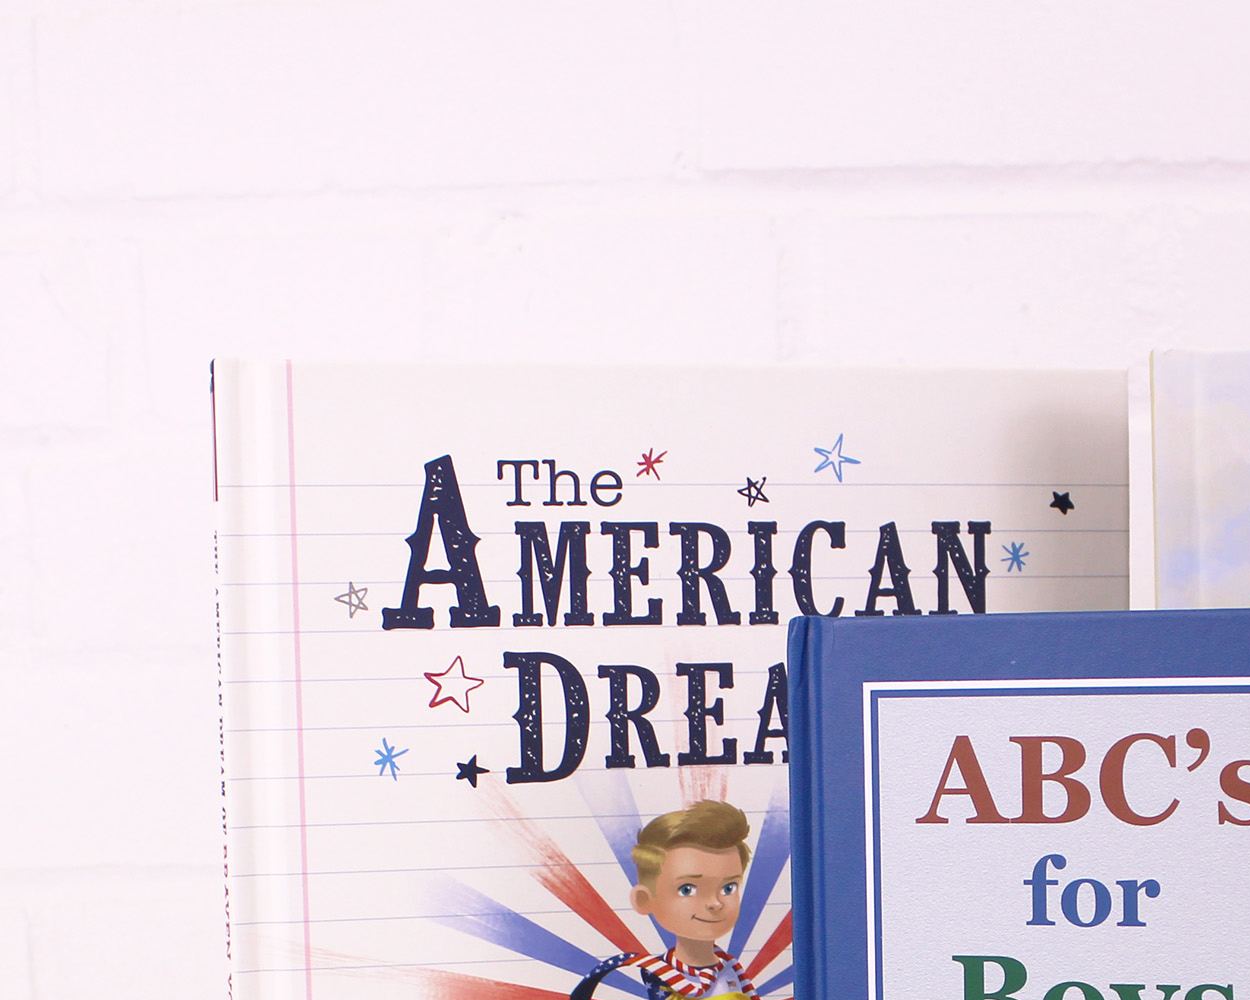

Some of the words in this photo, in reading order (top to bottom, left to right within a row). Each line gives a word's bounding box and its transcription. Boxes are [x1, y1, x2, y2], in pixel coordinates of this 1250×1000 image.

[497, 460, 623, 507] The
[382, 455, 992, 630] AMERICAN
[503, 652, 789, 785] DREA
[1023, 854, 1161, 927] for
